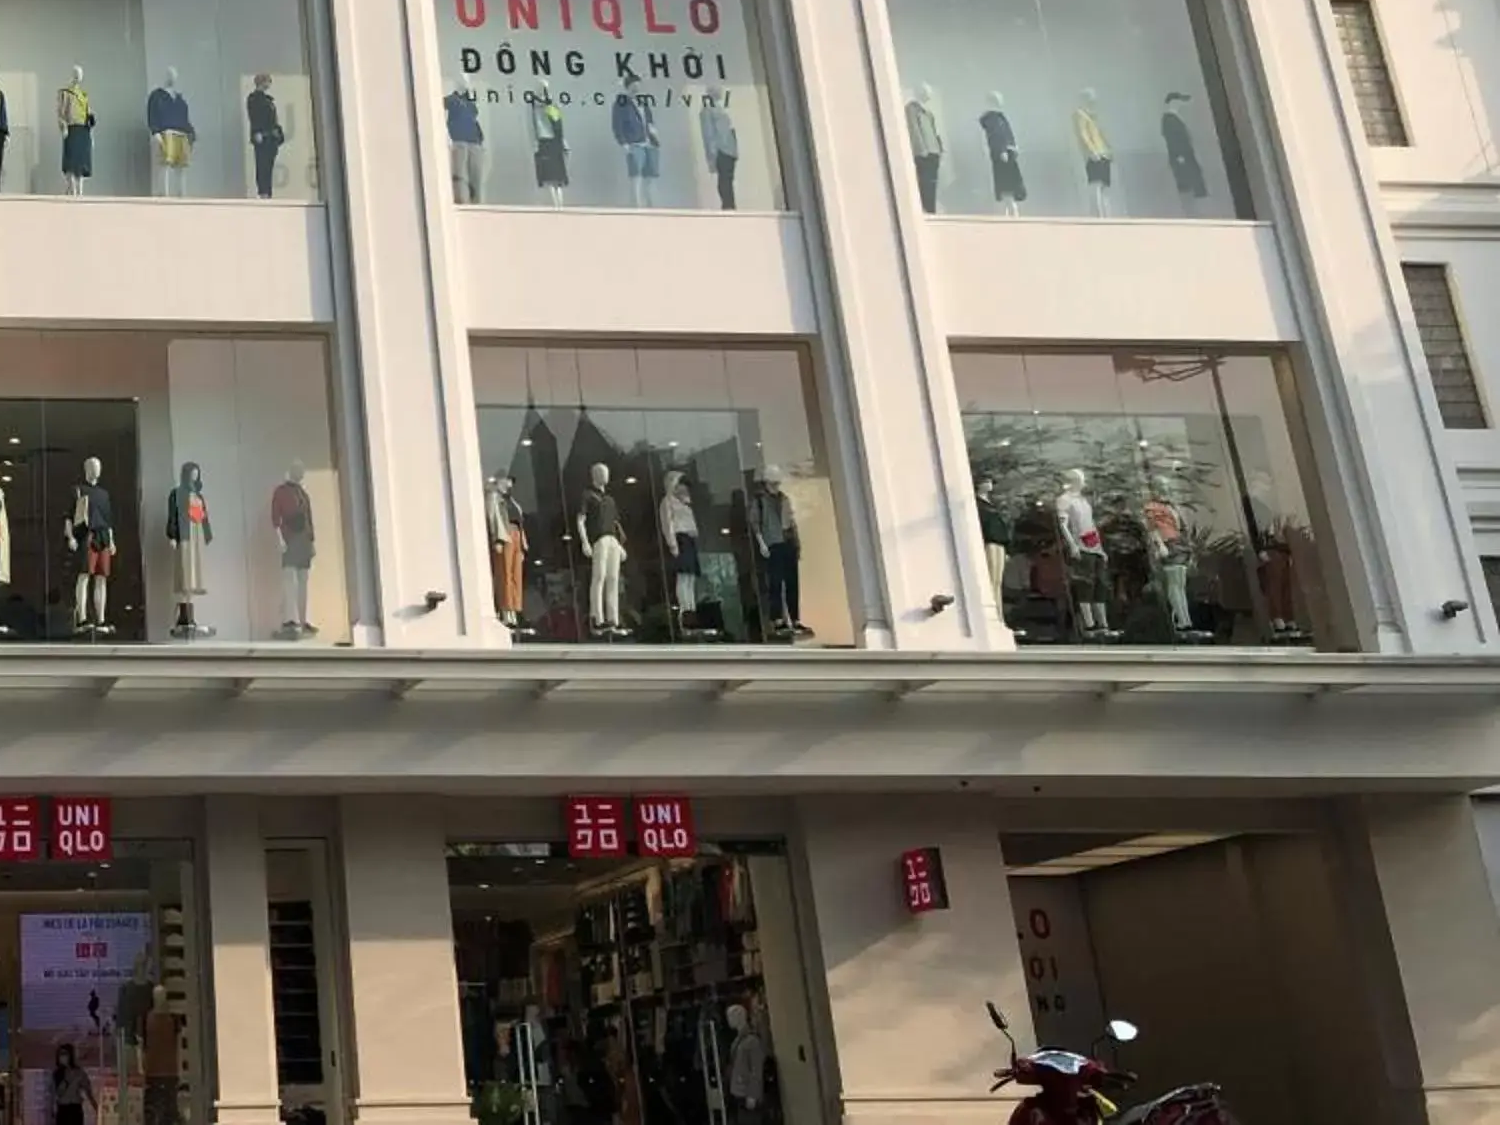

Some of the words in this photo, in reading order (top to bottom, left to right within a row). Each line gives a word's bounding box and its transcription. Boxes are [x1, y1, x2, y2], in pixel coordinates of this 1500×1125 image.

[58, 805, 100, 826] UNI
[640, 803, 681, 824] UNI
[59, 830, 104, 856] QLO
[643, 828, 688, 852] QLO
